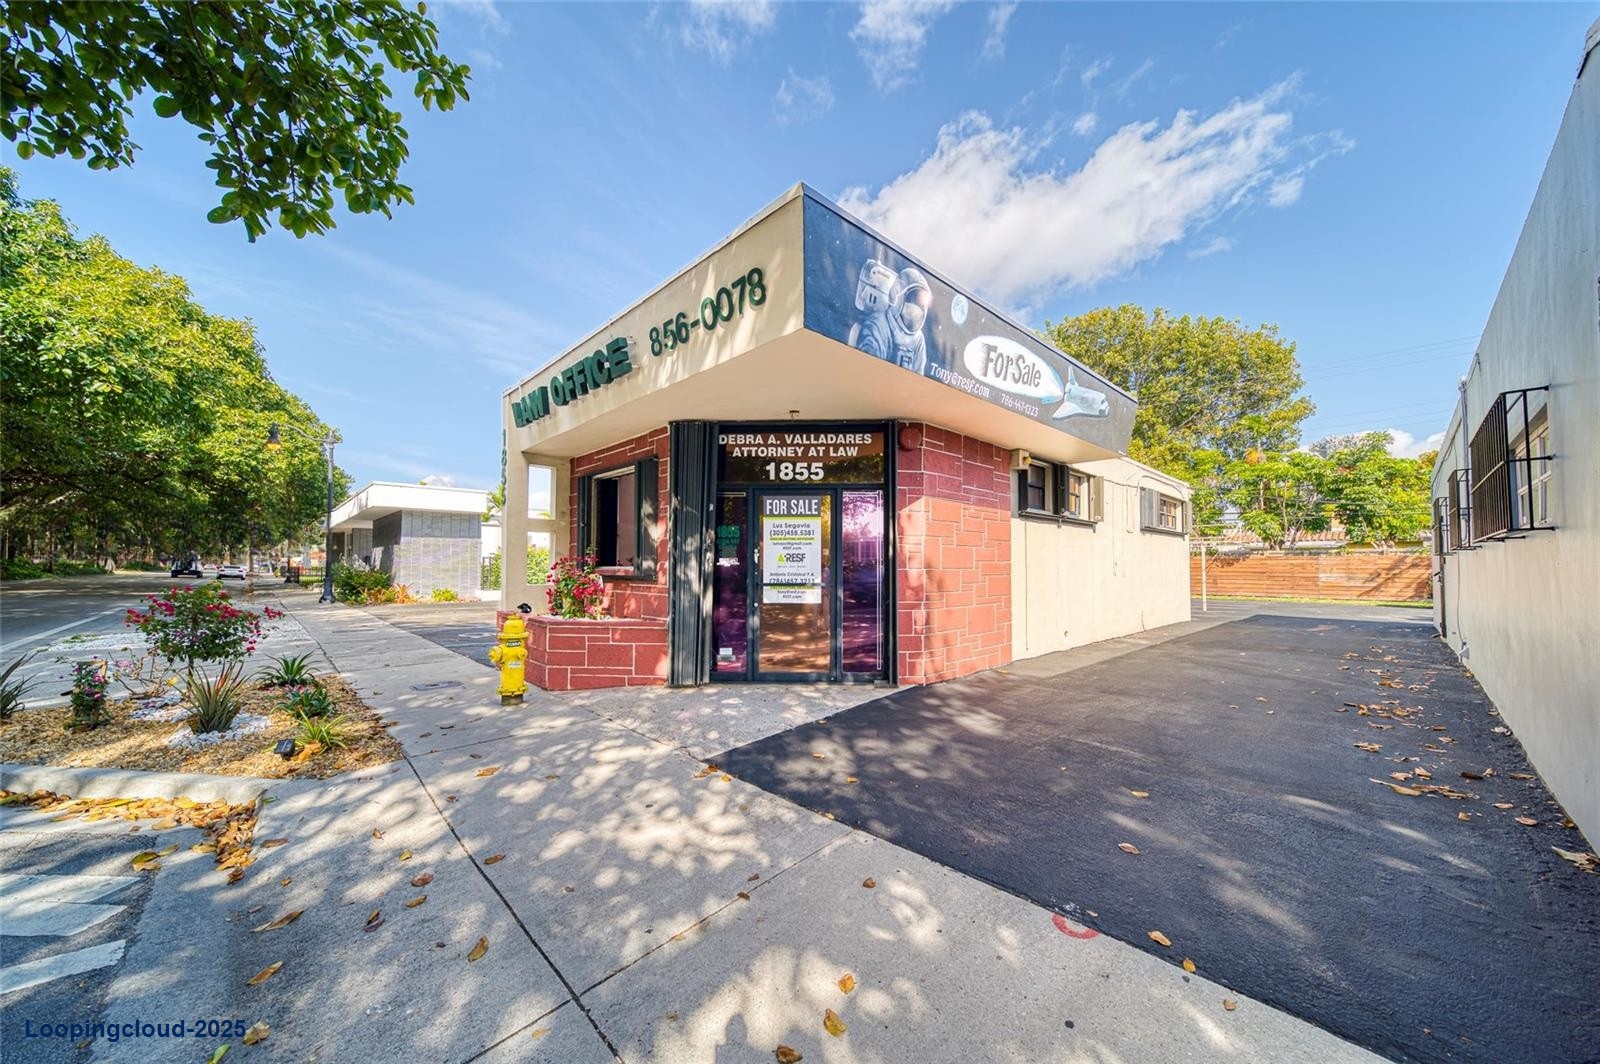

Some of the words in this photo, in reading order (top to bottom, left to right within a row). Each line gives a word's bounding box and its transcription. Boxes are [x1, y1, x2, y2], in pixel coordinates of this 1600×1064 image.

[649, 267, 768, 357] 856-0078
[511, 386, 550, 428] LAW
[550, 337, 633, 407] OFFICE
[718, 433, 764, 445] DEBRA
[767, 434, 781, 445] A.
[784, 433, 873, 445] VALLADARES
[732, 446, 803, 457] ATTORNEY
[808, 446, 826, 457] AT
[829, 446, 859, 457] LAW
[765, 462, 825, 481] 1855
[766, 499, 787, 515] FOR
[790, 499, 819, 515] SALE
[784, 522, 811, 530] Segovia
[785, 553, 806, 562] RESF
